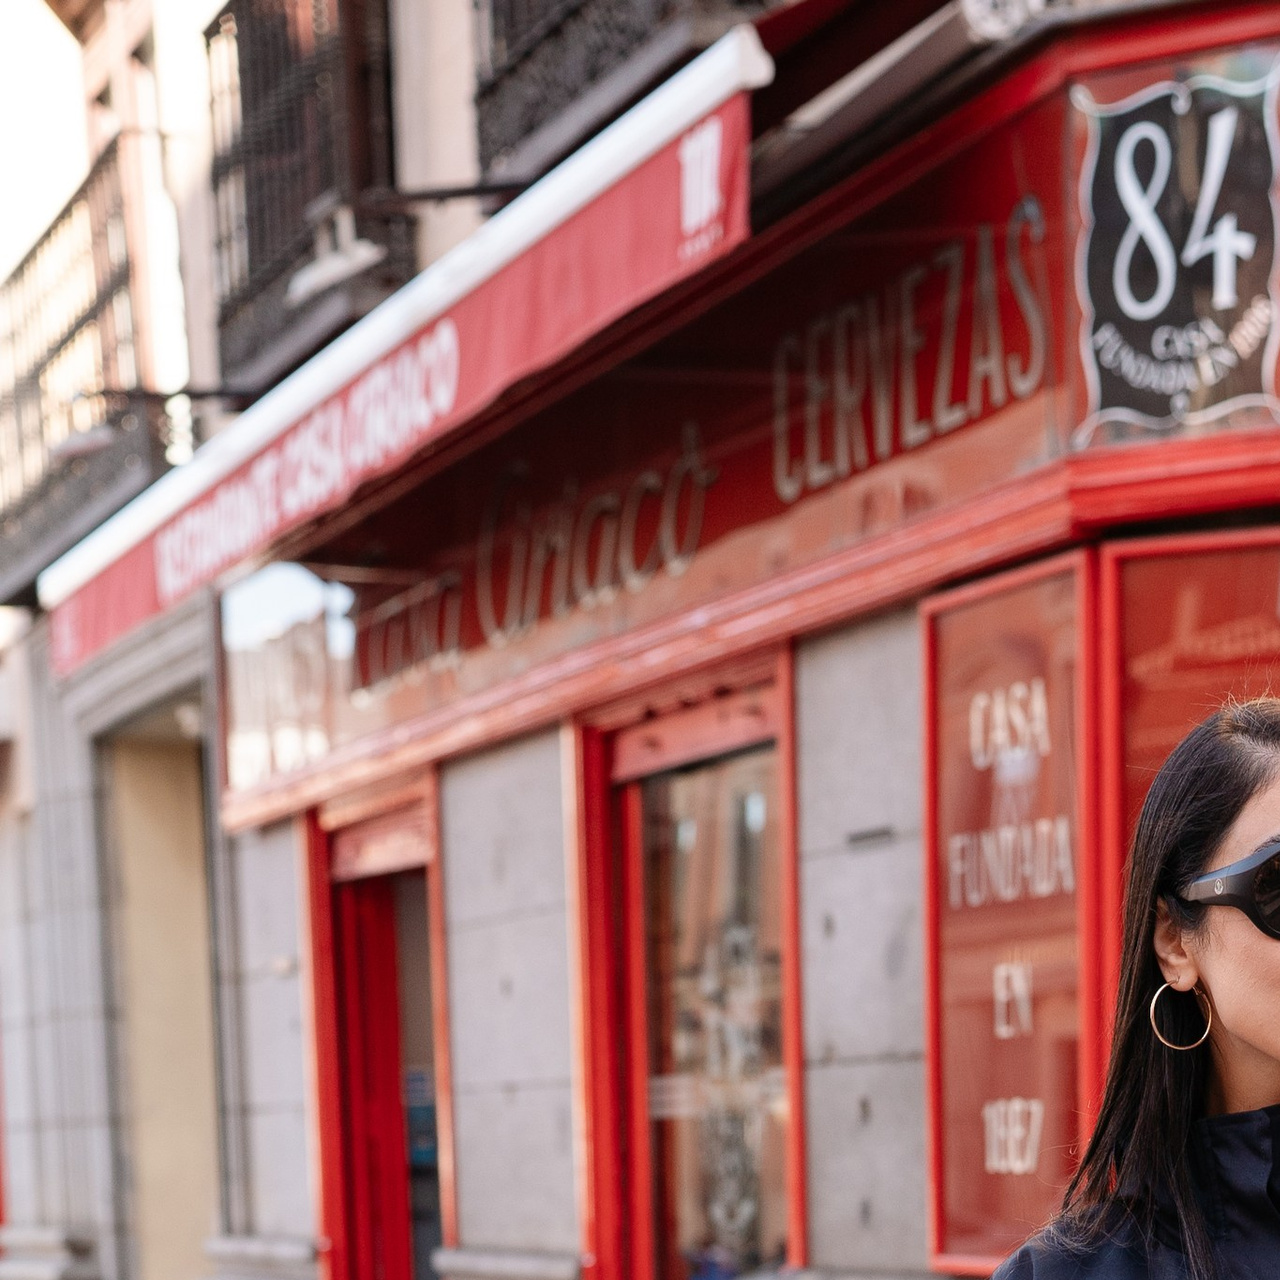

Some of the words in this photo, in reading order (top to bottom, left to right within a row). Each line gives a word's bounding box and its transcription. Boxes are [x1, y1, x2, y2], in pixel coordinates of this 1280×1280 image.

[1112, 105, 1257, 322] 84
[772, 195, 1047, 504] CERVEZAS
[1093, 321, 1200, 395] FUNDADA
[1151, 315, 1224, 361] CASA
[969, 677, 1050, 771] CASA
[948, 814, 1076, 910] FUNDADA
[993, 962, 1033, 1039] EN
